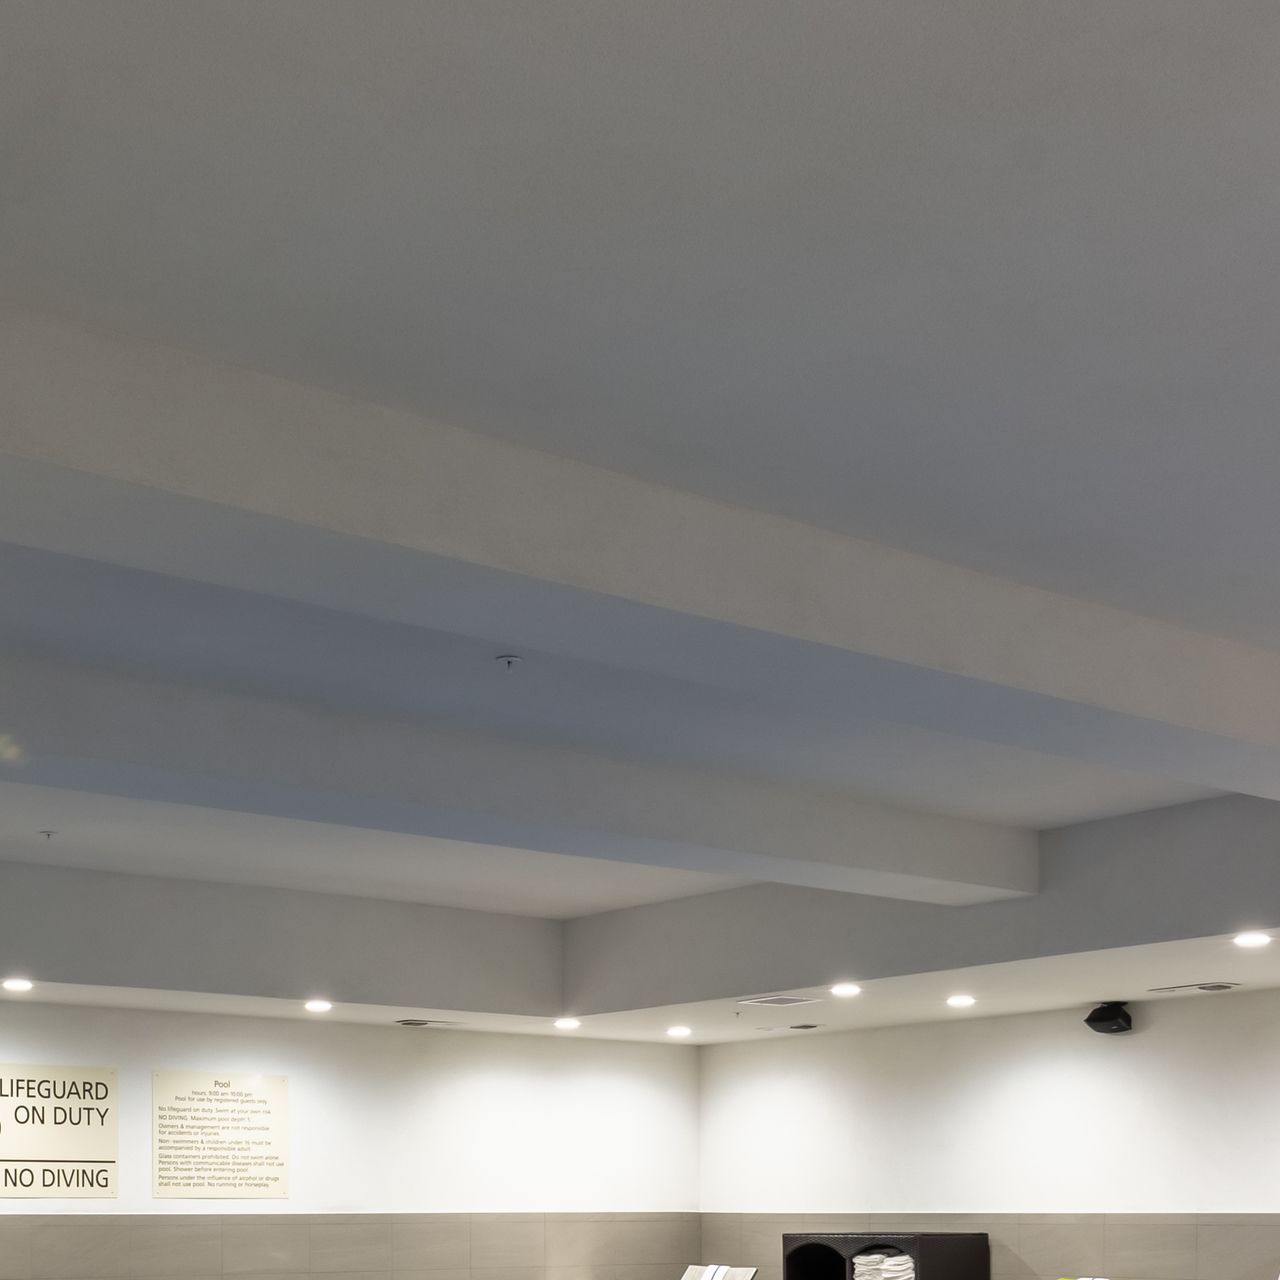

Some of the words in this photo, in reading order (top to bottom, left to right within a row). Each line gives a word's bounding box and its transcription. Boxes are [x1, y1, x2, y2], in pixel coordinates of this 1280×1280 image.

[0, 1078, 109, 1101] LIFEGUARD
[214, 1080, 231, 1088] Pool
[14, 1105, 45, 1125] ON
[53, 1106, 110, 1126] DUTY
[4, 1168, 34, 1188] NO
[42, 1168, 109, 1188] DIVING
